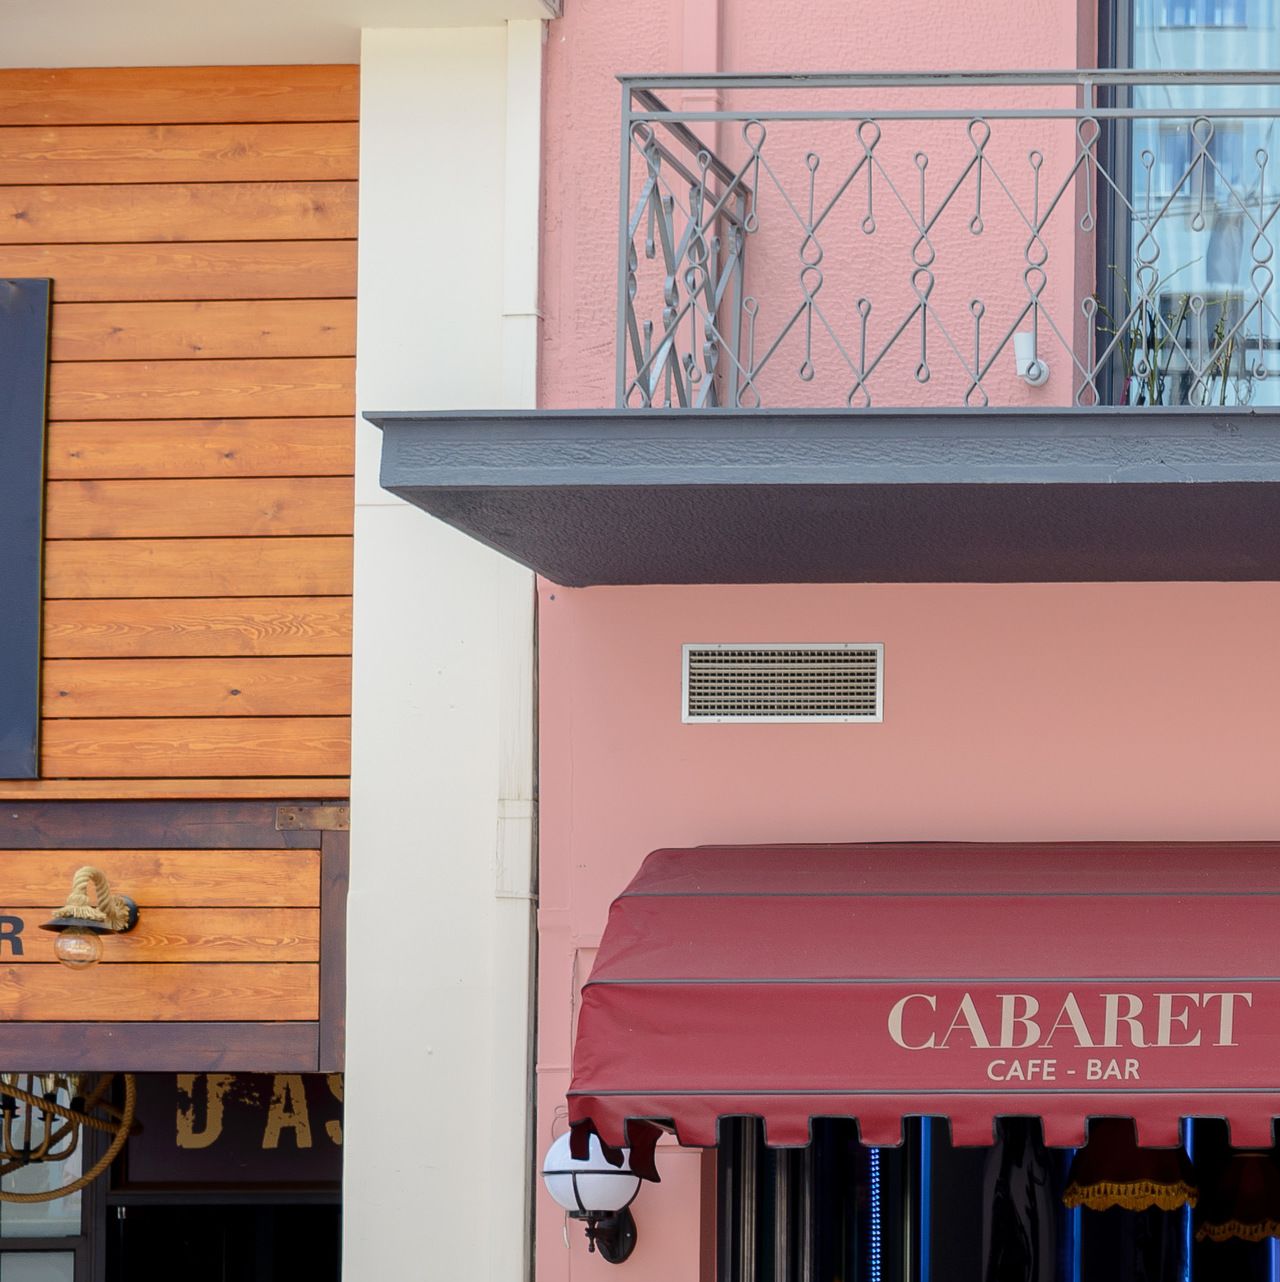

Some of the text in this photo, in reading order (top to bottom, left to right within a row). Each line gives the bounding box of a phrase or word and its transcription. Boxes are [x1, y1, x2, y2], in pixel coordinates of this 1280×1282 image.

[887, 991, 1253, 1050] CABARET
[987, 1059, 1057, 1081] CAFE
[1086, 1058, 1141, 1080] BAR
